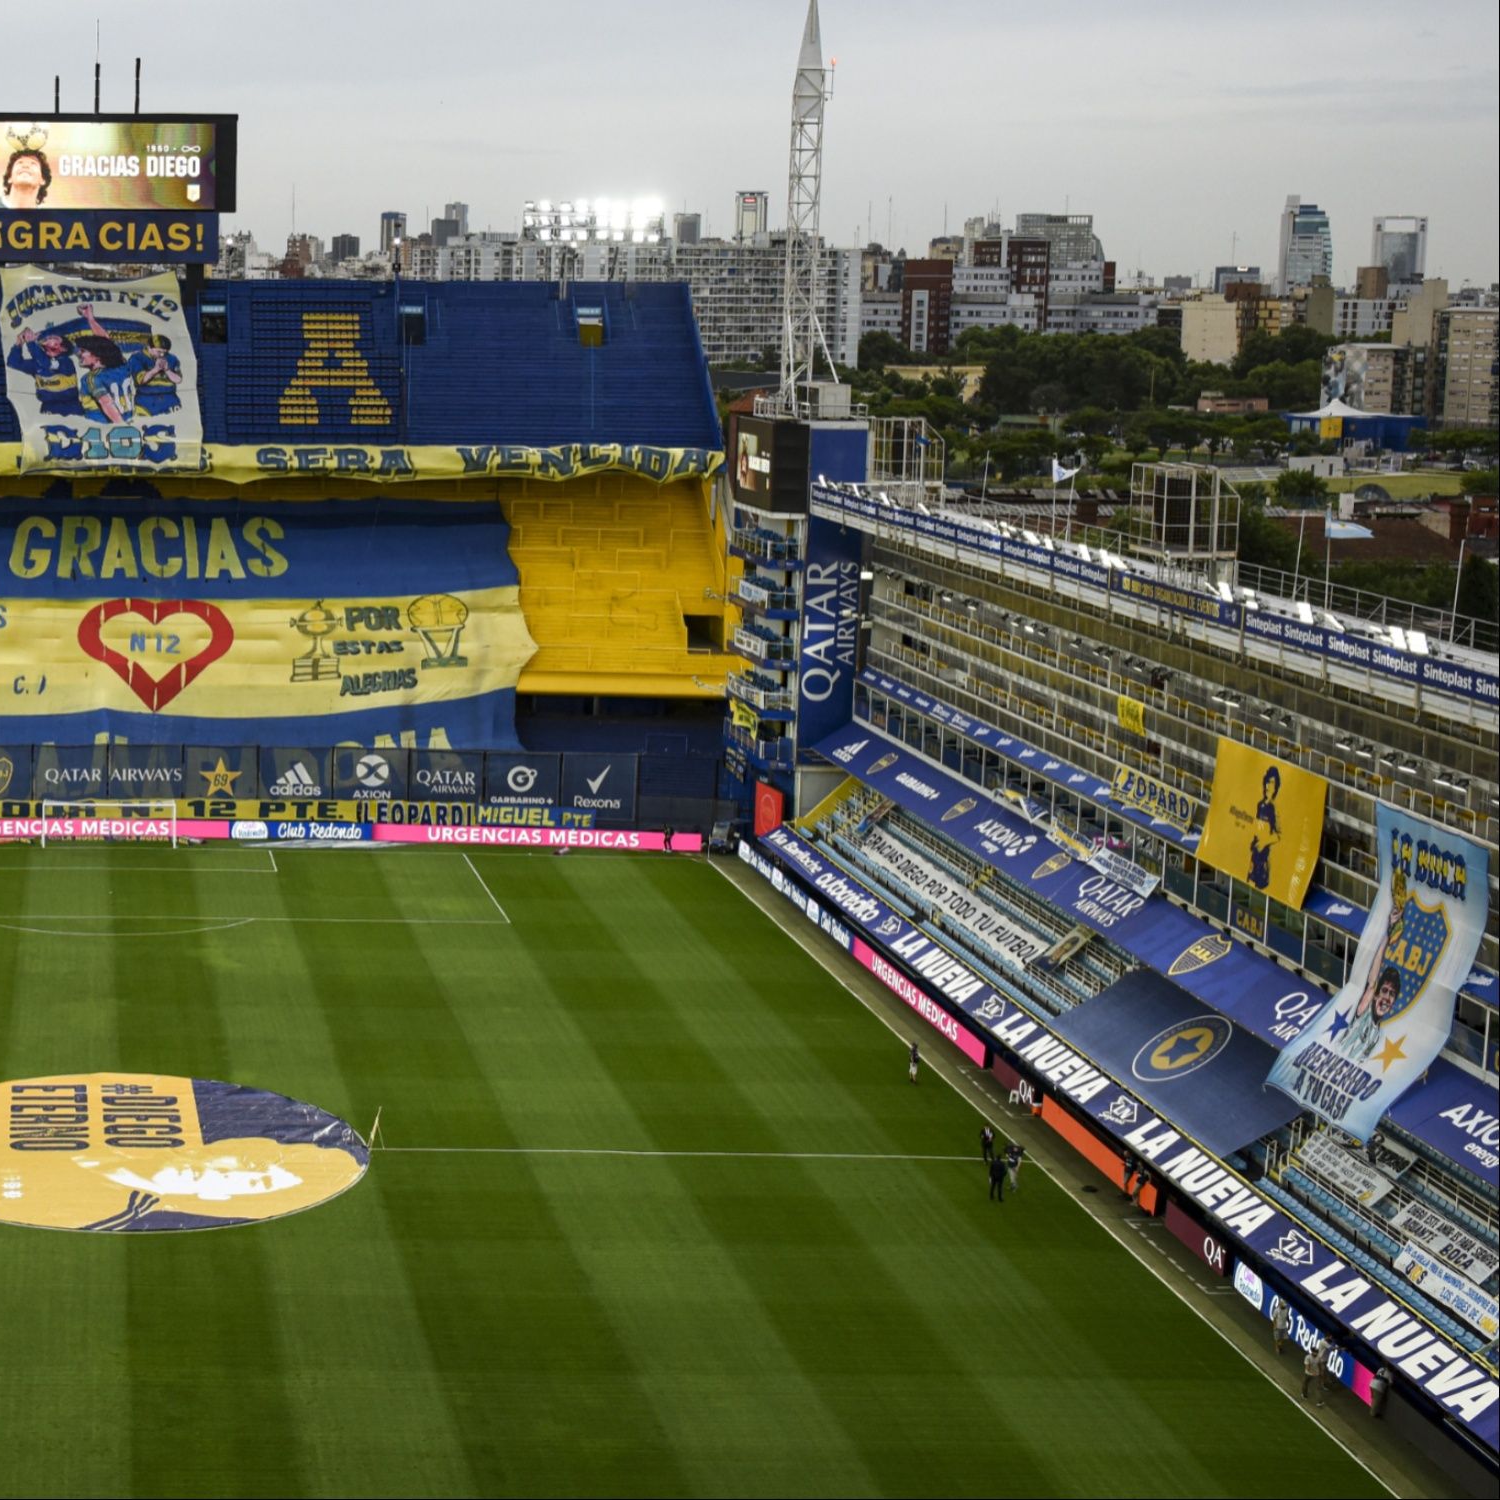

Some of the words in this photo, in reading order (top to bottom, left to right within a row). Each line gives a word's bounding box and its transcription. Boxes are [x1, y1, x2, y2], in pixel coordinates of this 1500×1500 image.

[59, 155, 140, 177] GRACIAS
[146, 156, 201, 178] DIEGO
[6, 284, 112, 328] JUGADOR
[143, 294, 178, 322] 12
[40, 424, 178, 464] D10S
[256, 447, 414, 475] SERA
[456, 443, 710, 481] VENCIDA
[9, 515, 290, 581] GRACIAS
[345, 605, 404, 632] POR
[801, 561, 841, 702] QATAR
[836, 561, 859, 666] AIRWAYS
[332, 640, 405, 657] ESTAS
[1245, 614, 1282, 636] Sinteplast
[1284, 624, 1323, 649] Sinteplast
[1328, 635, 1370, 660] Sinteplast
[1373, 649, 1417, 675] Sinteplast
[1423, 663, 1472, 691] Sinteplast
[339, 667, 419, 698] ALEGRIAS
[44, 768, 102, 784] QATAR
[110, 768, 183, 782] AIRWAYS
[214, 772, 228, 786] 69
[270, 783, 322, 796] adidas
[416, 769, 476, 786] QATAR
[430, 784, 476, 795] AIRWAYS
[352, 790, 392, 799] AXION
[574, 795, 620, 809] Rexona
[187, 802, 236, 817] 12
[258, 802, 344, 819] PTE.
[478, 806, 556, 826] MIGUEL
[561, 812, 592, 828] PTE
[82, 820, 170, 836] MÉDICAS
[278, 824, 306, 838] Club
[309, 823, 362, 840] Redondo
[427, 826, 542, 844] URGENCIAS
[550, 829, 640, 848] MÉDICAS
[974, 819, 1020, 848] AXION
[864, 829, 900, 866] GRACIAS
[897, 851, 928, 886] DIEGO
[923, 876, 948, 900] POR
[942, 892, 977, 920] TODO
[972, 912, 996, 932] TU
[988, 924, 1042, 966] FUTBOL
[1078, 875, 1145, 918] QATAR
[1072, 899, 1120, 927] AIRWAYS
[1235, 909, 1263, 938] CABJ
[890, 932, 920, 958] LA
[912, 948, 985, 1003] NUEVA
[871, 954, 917, 1006] URGENCIAS
[918, 992, 958, 1042] MÉDICAS
[990, 1011, 1038, 1047] LA
[1018, 1032, 1111, 1104] NUEVA
[1293, 1041, 1382, 1102] BIENVENIDO
[9, 1084, 90, 1151] ETERNO
[100, 1083, 185, 1148] #DIEGO
[1439, 1103, 1499, 1150] AXIO
[1123, 1117, 1180, 1159] LA
[1160, 1146, 1275, 1238] NUEVA
[1283, 1241, 1307, 1259] LN
[1439, 1243, 1474, 1270] BOCA
[1300, 1261, 1370, 1315] LA
[1350, 1302, 1500, 1423] NUEVA
